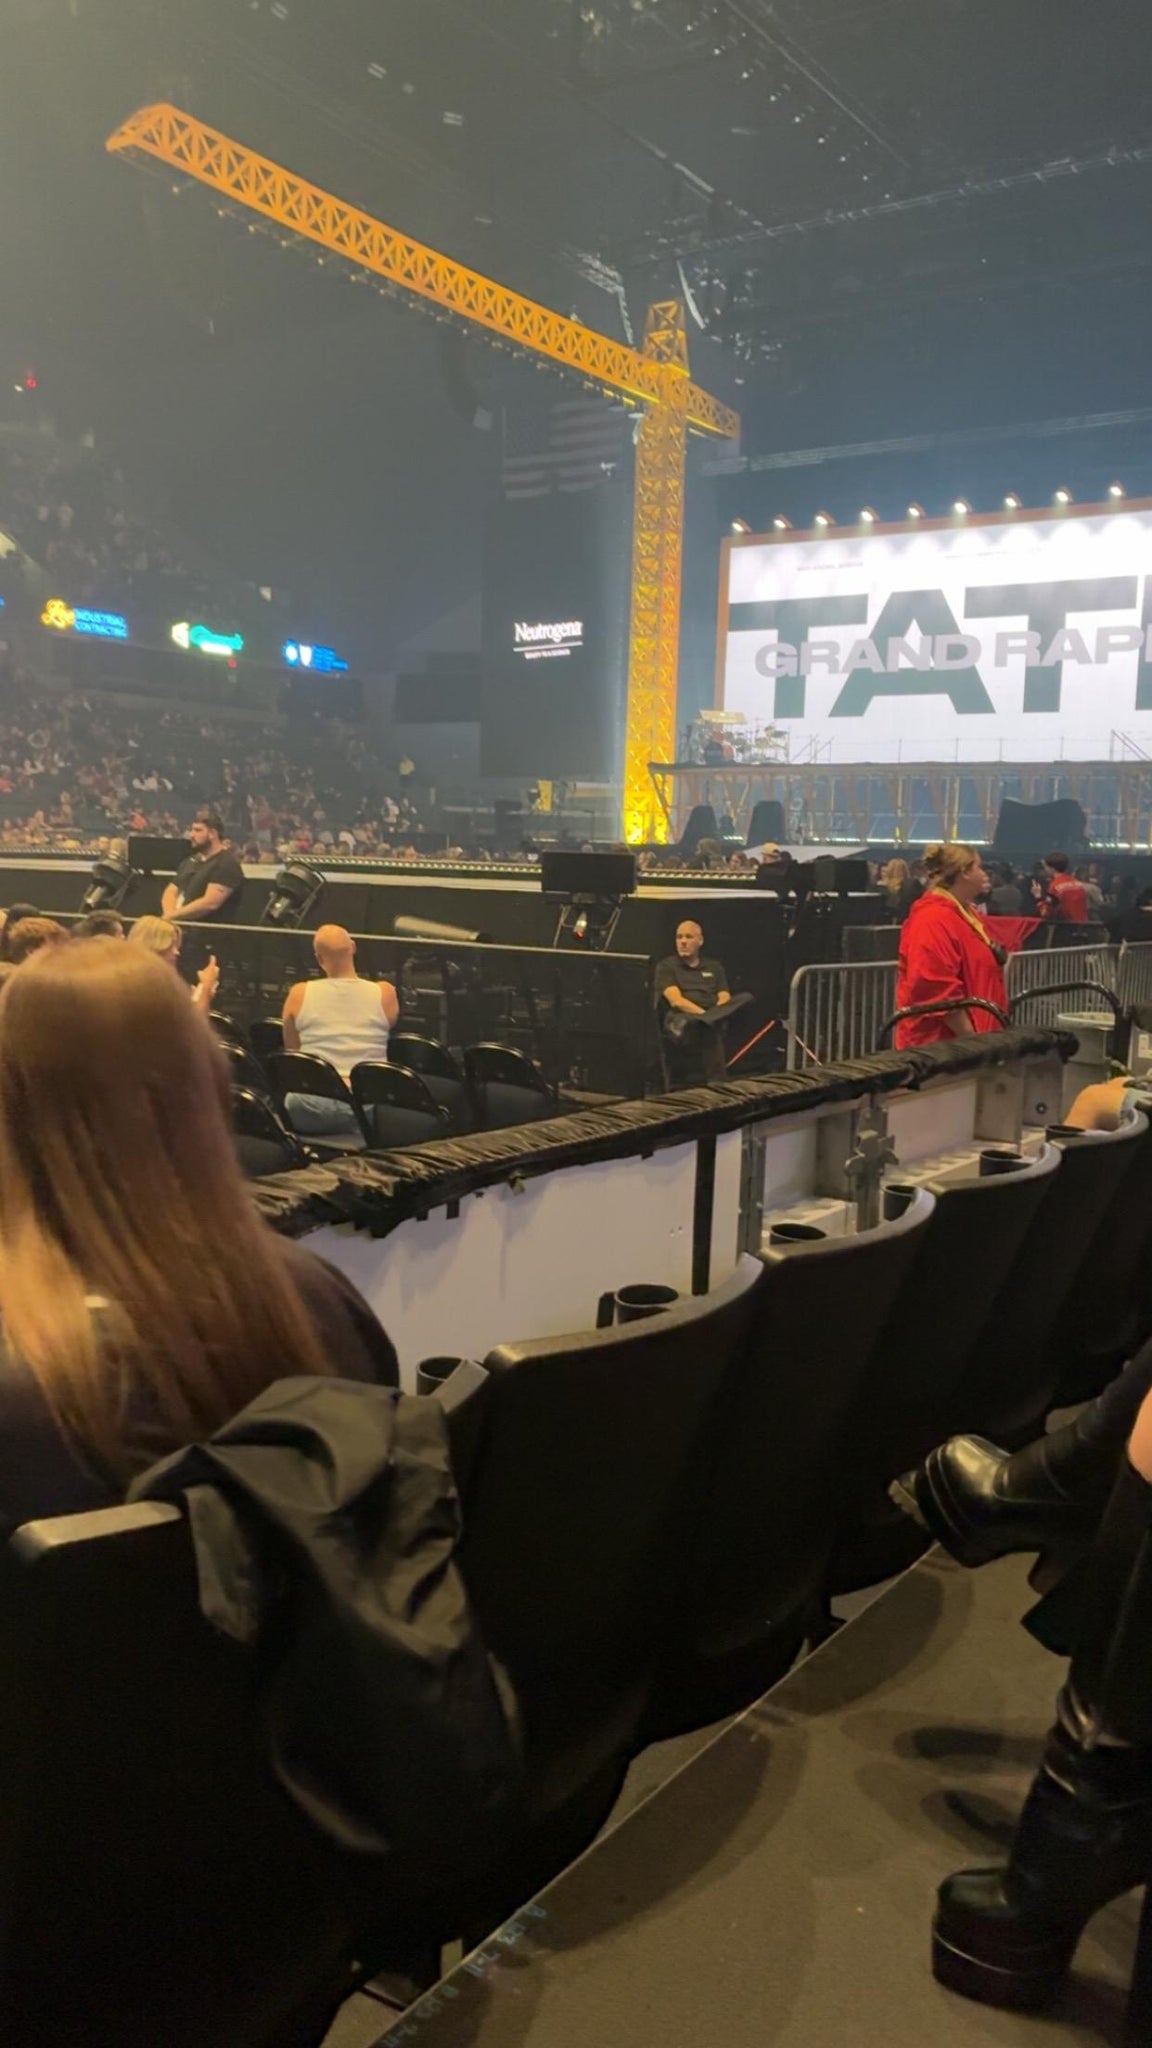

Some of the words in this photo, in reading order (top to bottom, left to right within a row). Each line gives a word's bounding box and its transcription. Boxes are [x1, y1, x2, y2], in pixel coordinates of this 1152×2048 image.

[514, 621, 583, 643] Neutrogena
[729, 574, 1152, 719] TAT
[754, 634, 982, 678] GRAND
